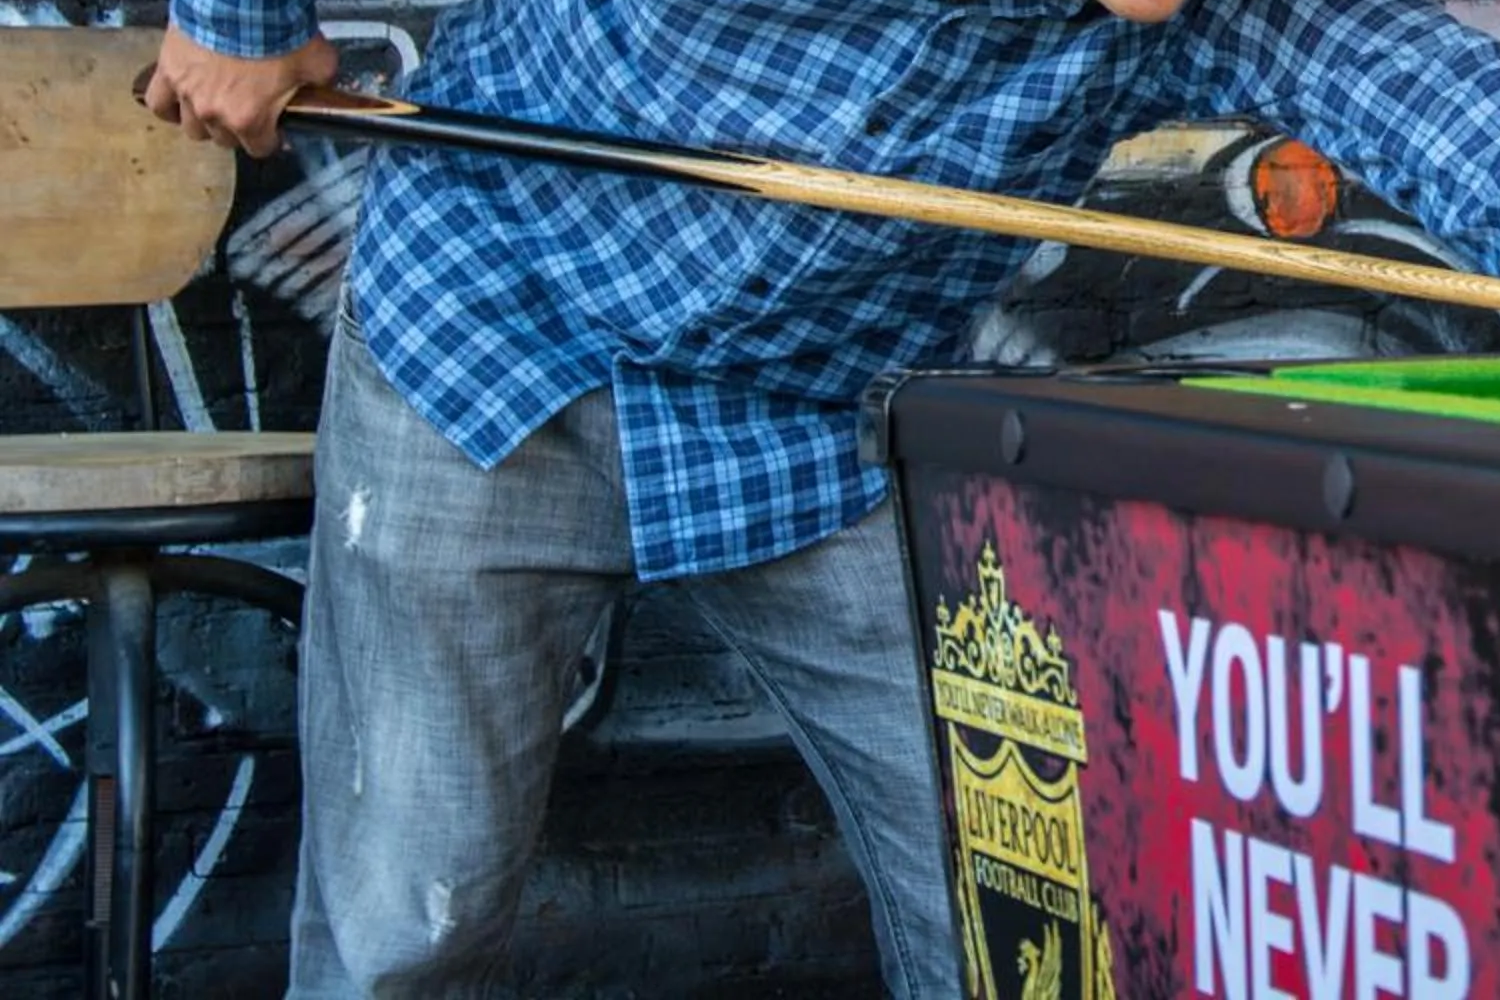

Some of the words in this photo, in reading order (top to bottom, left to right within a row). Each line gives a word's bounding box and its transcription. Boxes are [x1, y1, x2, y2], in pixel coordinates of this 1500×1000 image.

[1157, 609, 1455, 864] YOU'LL
[965, 785, 1077, 874] LIVERPOOL
[974, 855, 1041, 909] FOOTBALL
[1042, 881, 1078, 923] CLUB
